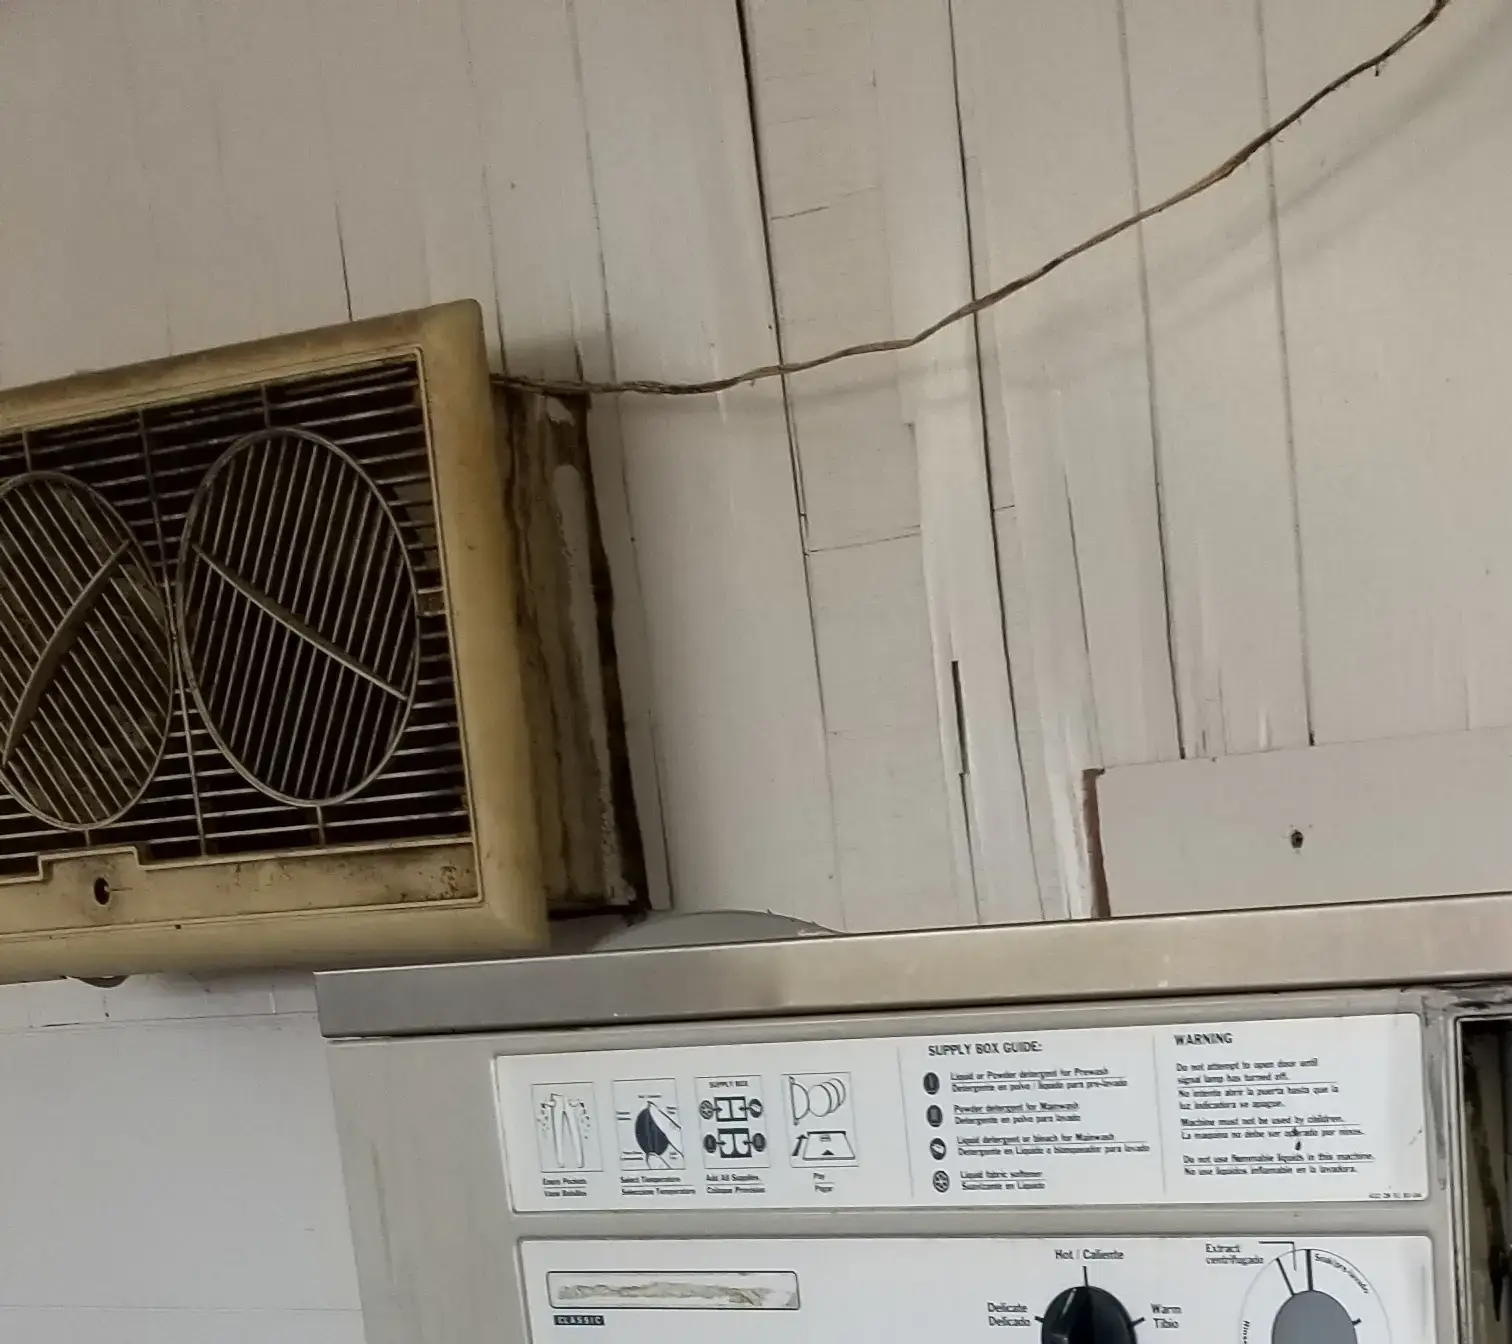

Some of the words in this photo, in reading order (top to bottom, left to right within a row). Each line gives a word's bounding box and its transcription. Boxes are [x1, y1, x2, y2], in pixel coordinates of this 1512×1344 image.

[1174, 1032, 1232, 1045] WARNING
[928, 1044, 971, 1056] SUPPLY
[975, 1042, 1000, 1055] BOX
[1055, 1249, 1074, 1260] Hot
[986, 1302, 1028, 1313] Delicate
[1151, 1304, 1182, 1315] Warm
